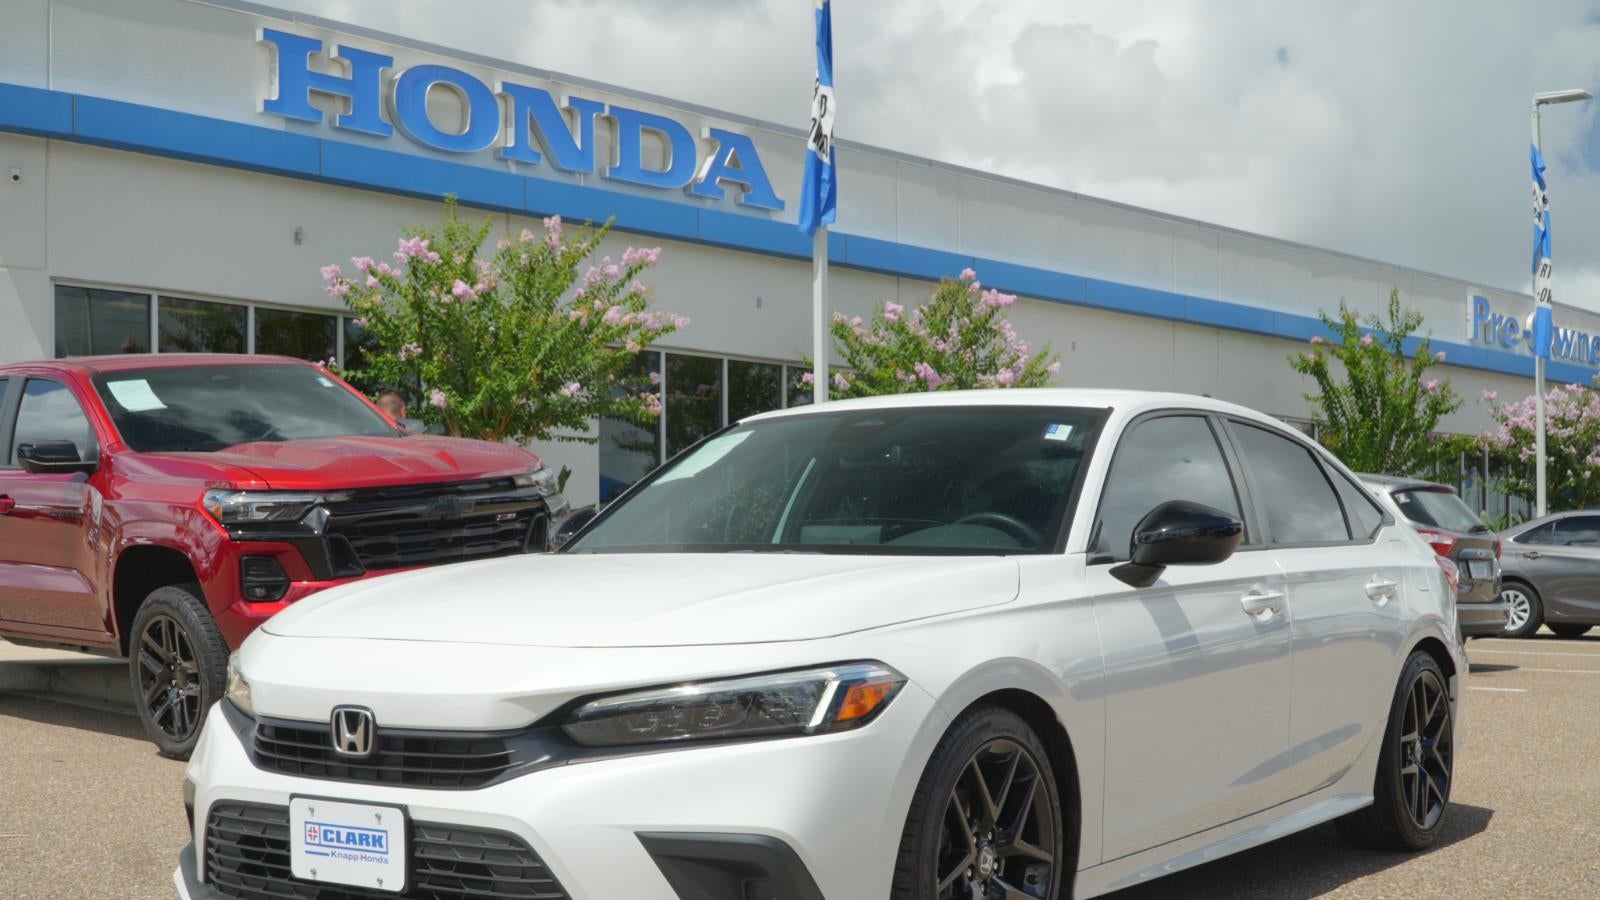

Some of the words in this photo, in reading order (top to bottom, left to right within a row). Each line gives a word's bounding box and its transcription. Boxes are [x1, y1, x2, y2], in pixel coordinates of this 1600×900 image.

[256, 27, 786, 212] HONDA
[1467, 295, 1600, 364] Pre-wne
[323, 829, 384, 848] CLARK
[330, 850, 359, 862] Knapp
[360, 853, 389, 864] Honda
